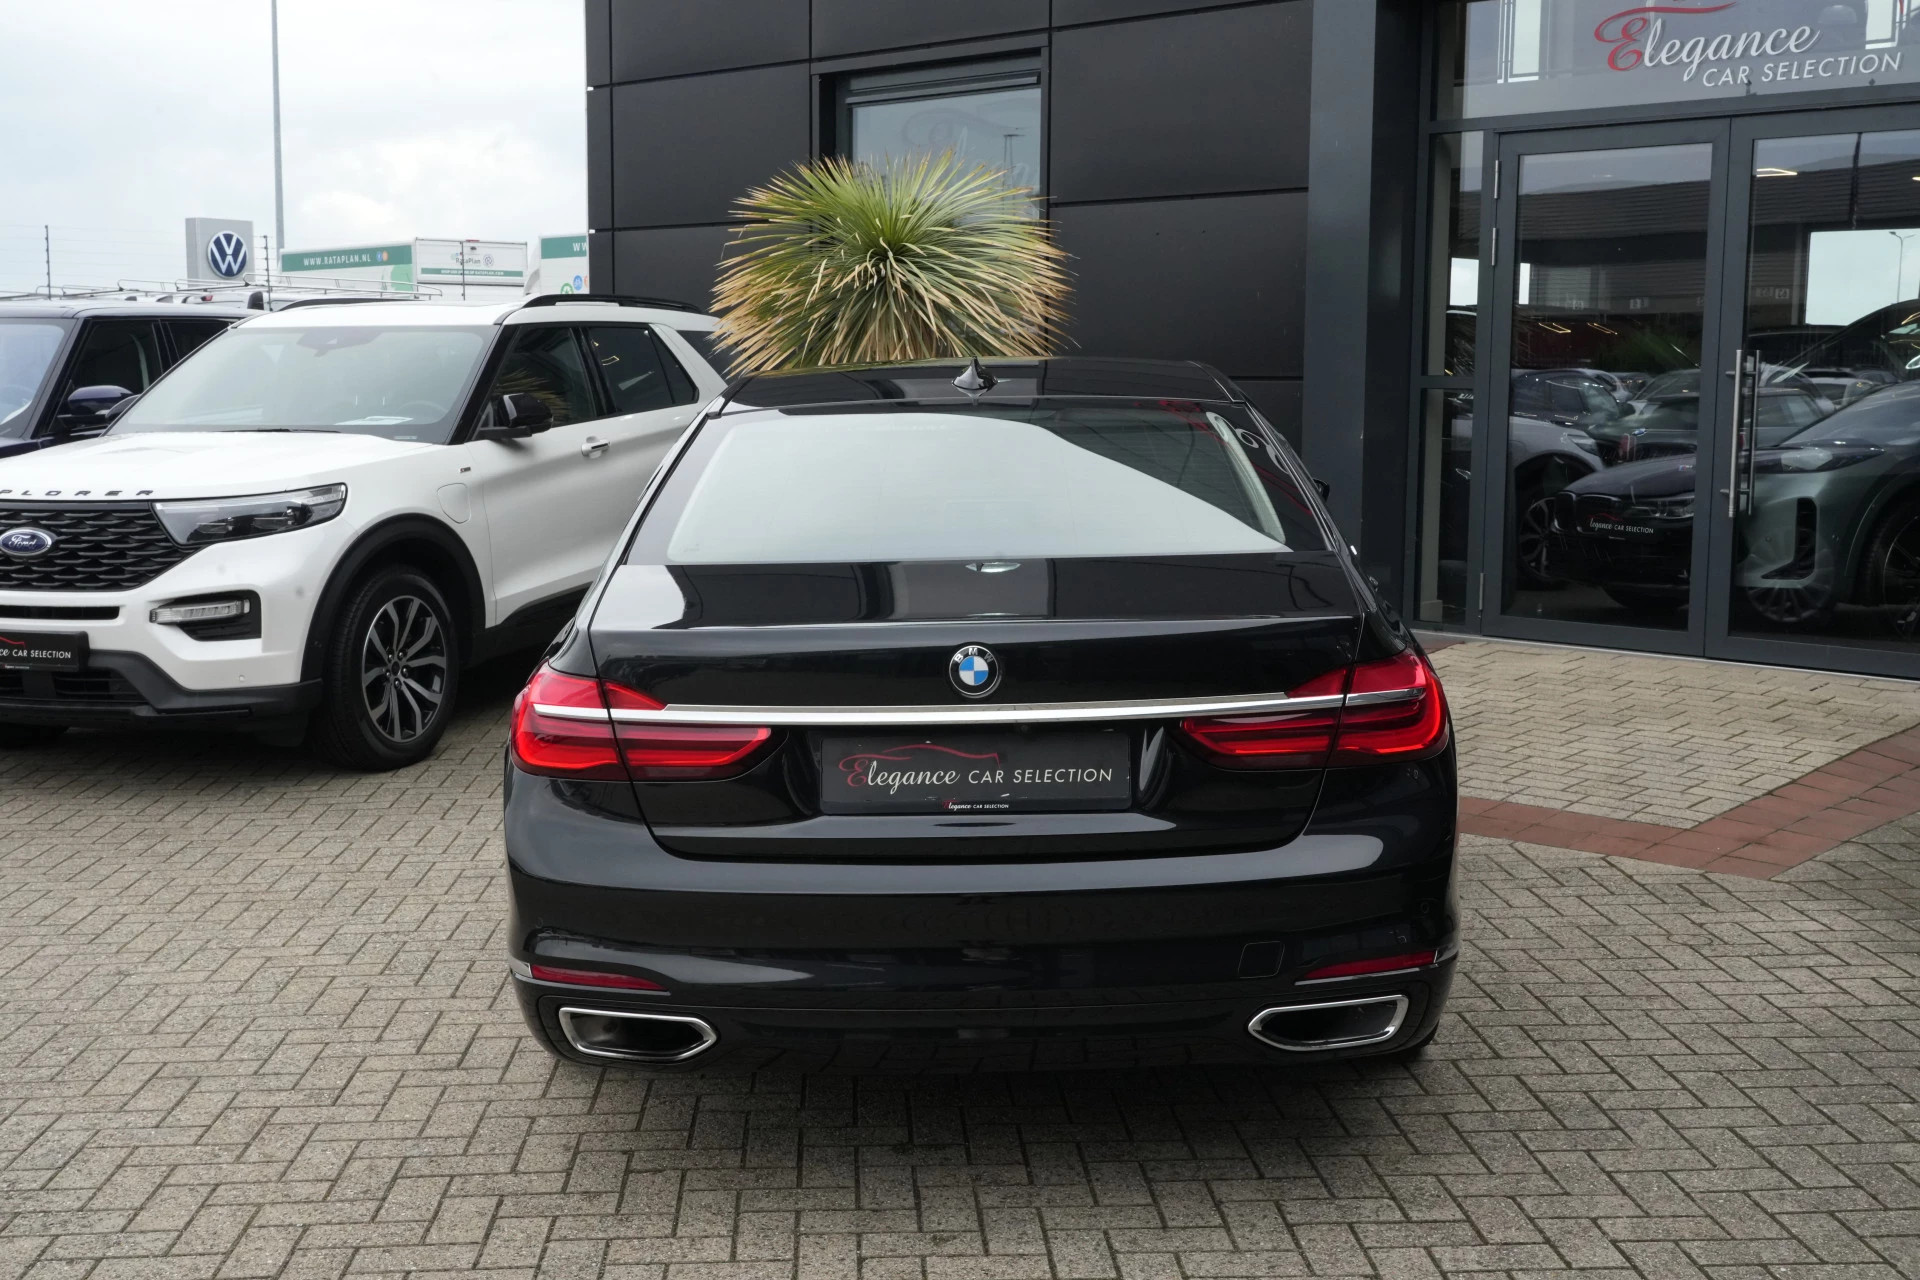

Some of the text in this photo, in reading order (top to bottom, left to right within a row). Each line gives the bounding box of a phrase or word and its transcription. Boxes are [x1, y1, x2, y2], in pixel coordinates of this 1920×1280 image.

[1595, 15, 1820, 82] Elegance
[1702, 52, 1901, 87] CAR SELECTION
[303, 253, 371, 266] WWW.RATAPLAN.NL
[1626, 525, 1654, 534] SELECTION
[8, 534, 37, 549] Ford
[12, 649, 28, 657] CAR
[30, 649, 71, 659] SELECTION
[954, 647, 994, 663] BMW
[844, 757, 1113, 794] Elegance CAR SELECTION
